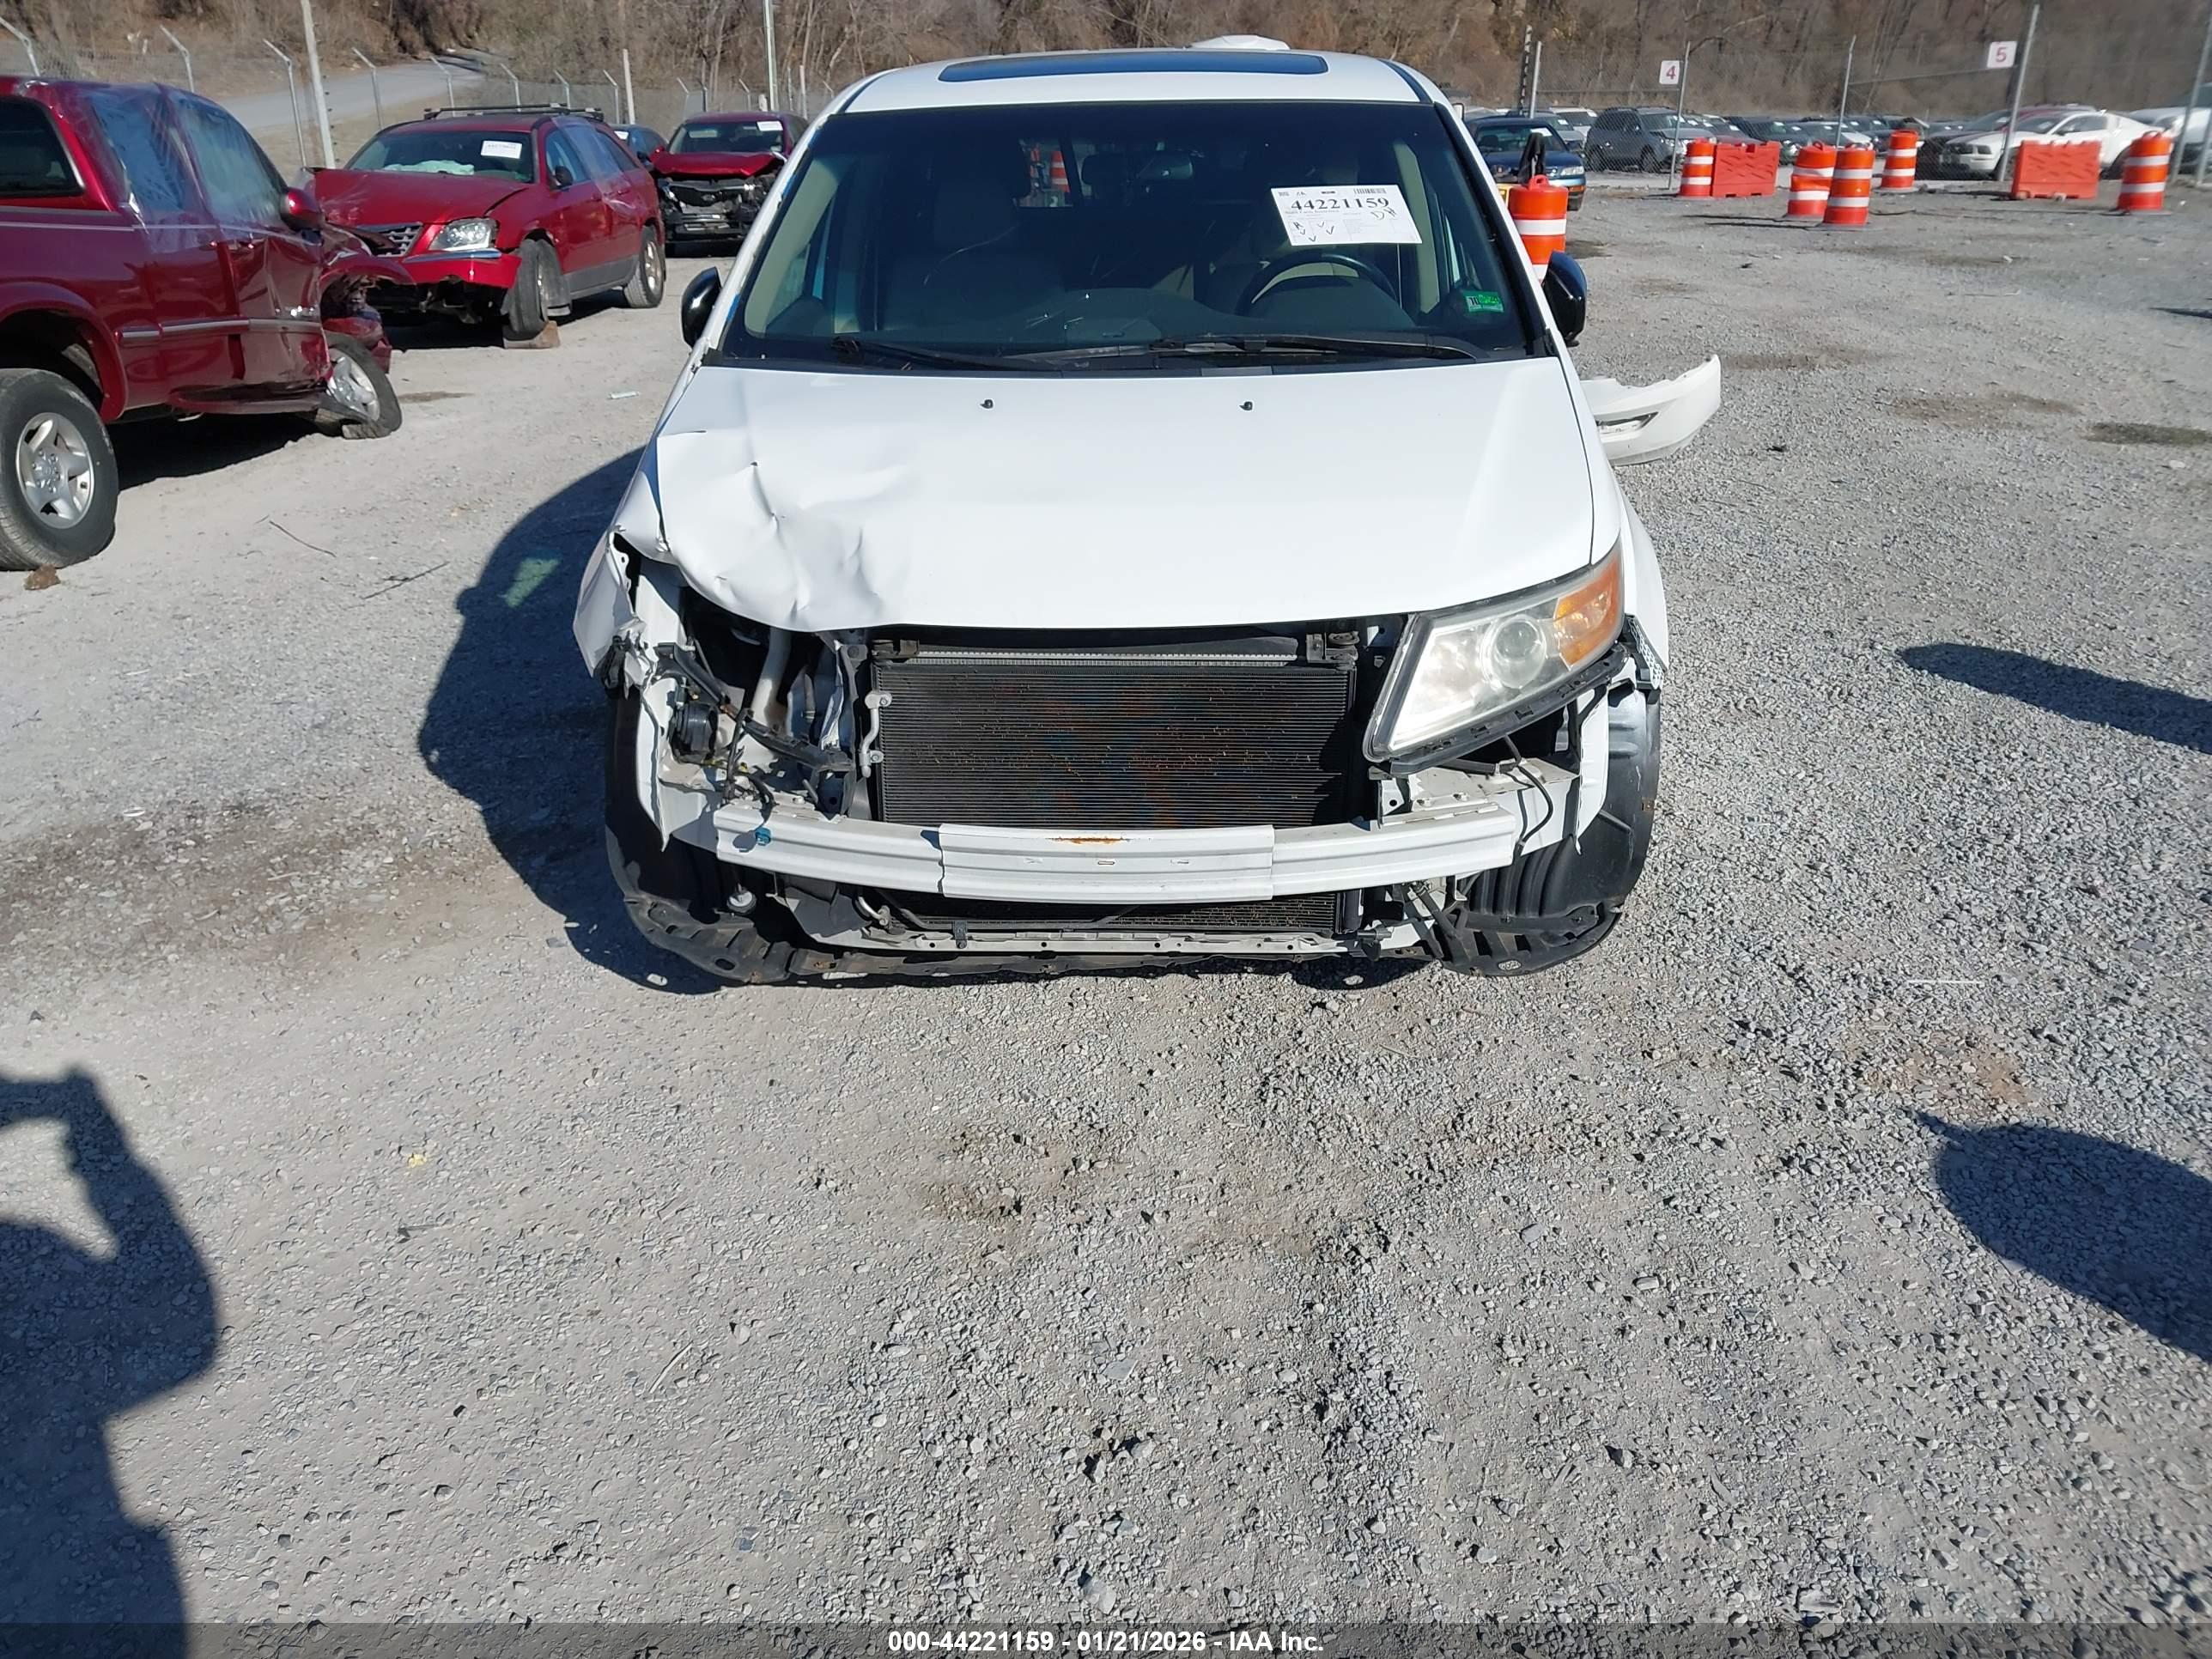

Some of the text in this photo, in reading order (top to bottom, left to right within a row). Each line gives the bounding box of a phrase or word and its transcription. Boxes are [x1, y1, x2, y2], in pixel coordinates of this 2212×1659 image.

[1995, 46, 2007, 63] 5
[1666, 65, 1677, 80] 4
[1291, 198, 1389, 210] 44221159
